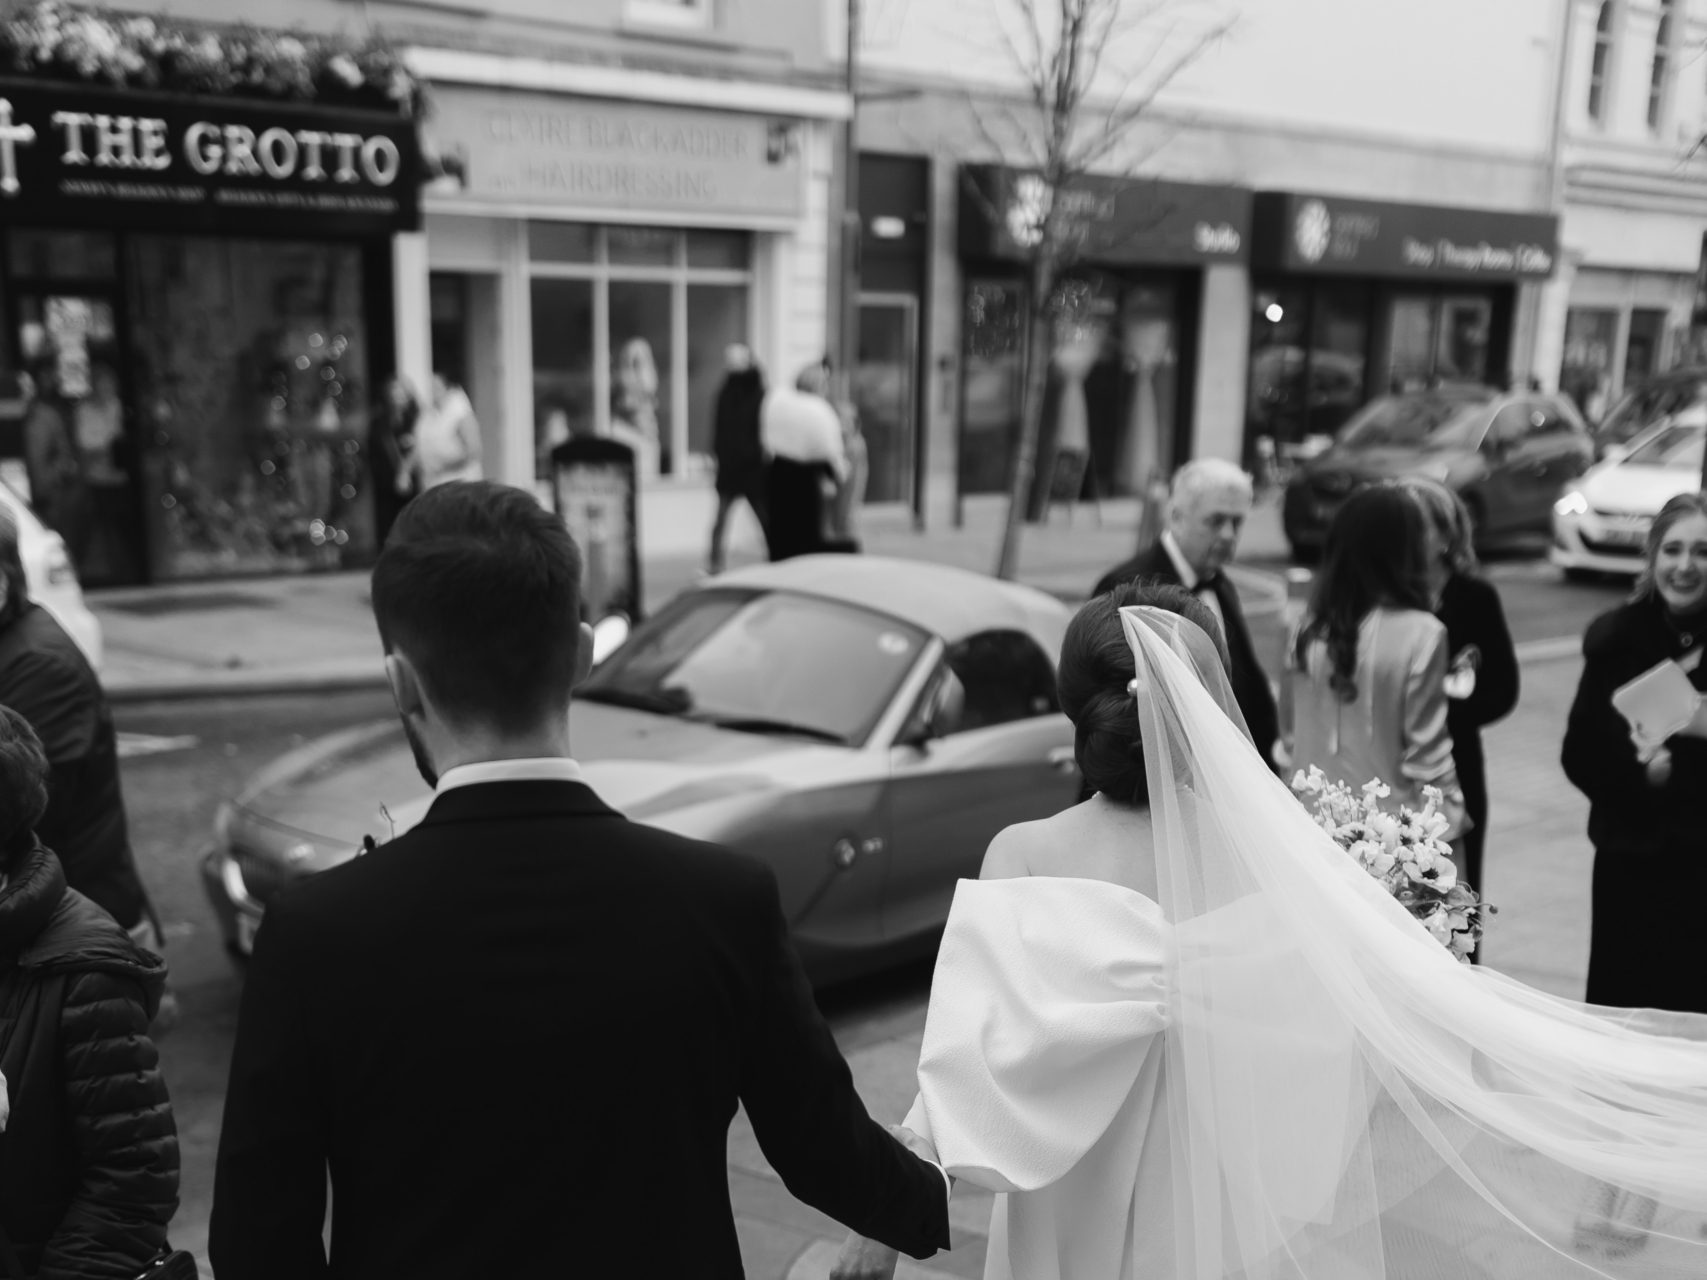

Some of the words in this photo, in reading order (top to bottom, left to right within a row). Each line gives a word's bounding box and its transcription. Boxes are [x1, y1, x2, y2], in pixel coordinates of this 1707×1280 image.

[52, 111, 172, 170] THE
[184, 121, 400, 187] GROTTO
[523, 162, 718, 198] HAIRDRESSING
